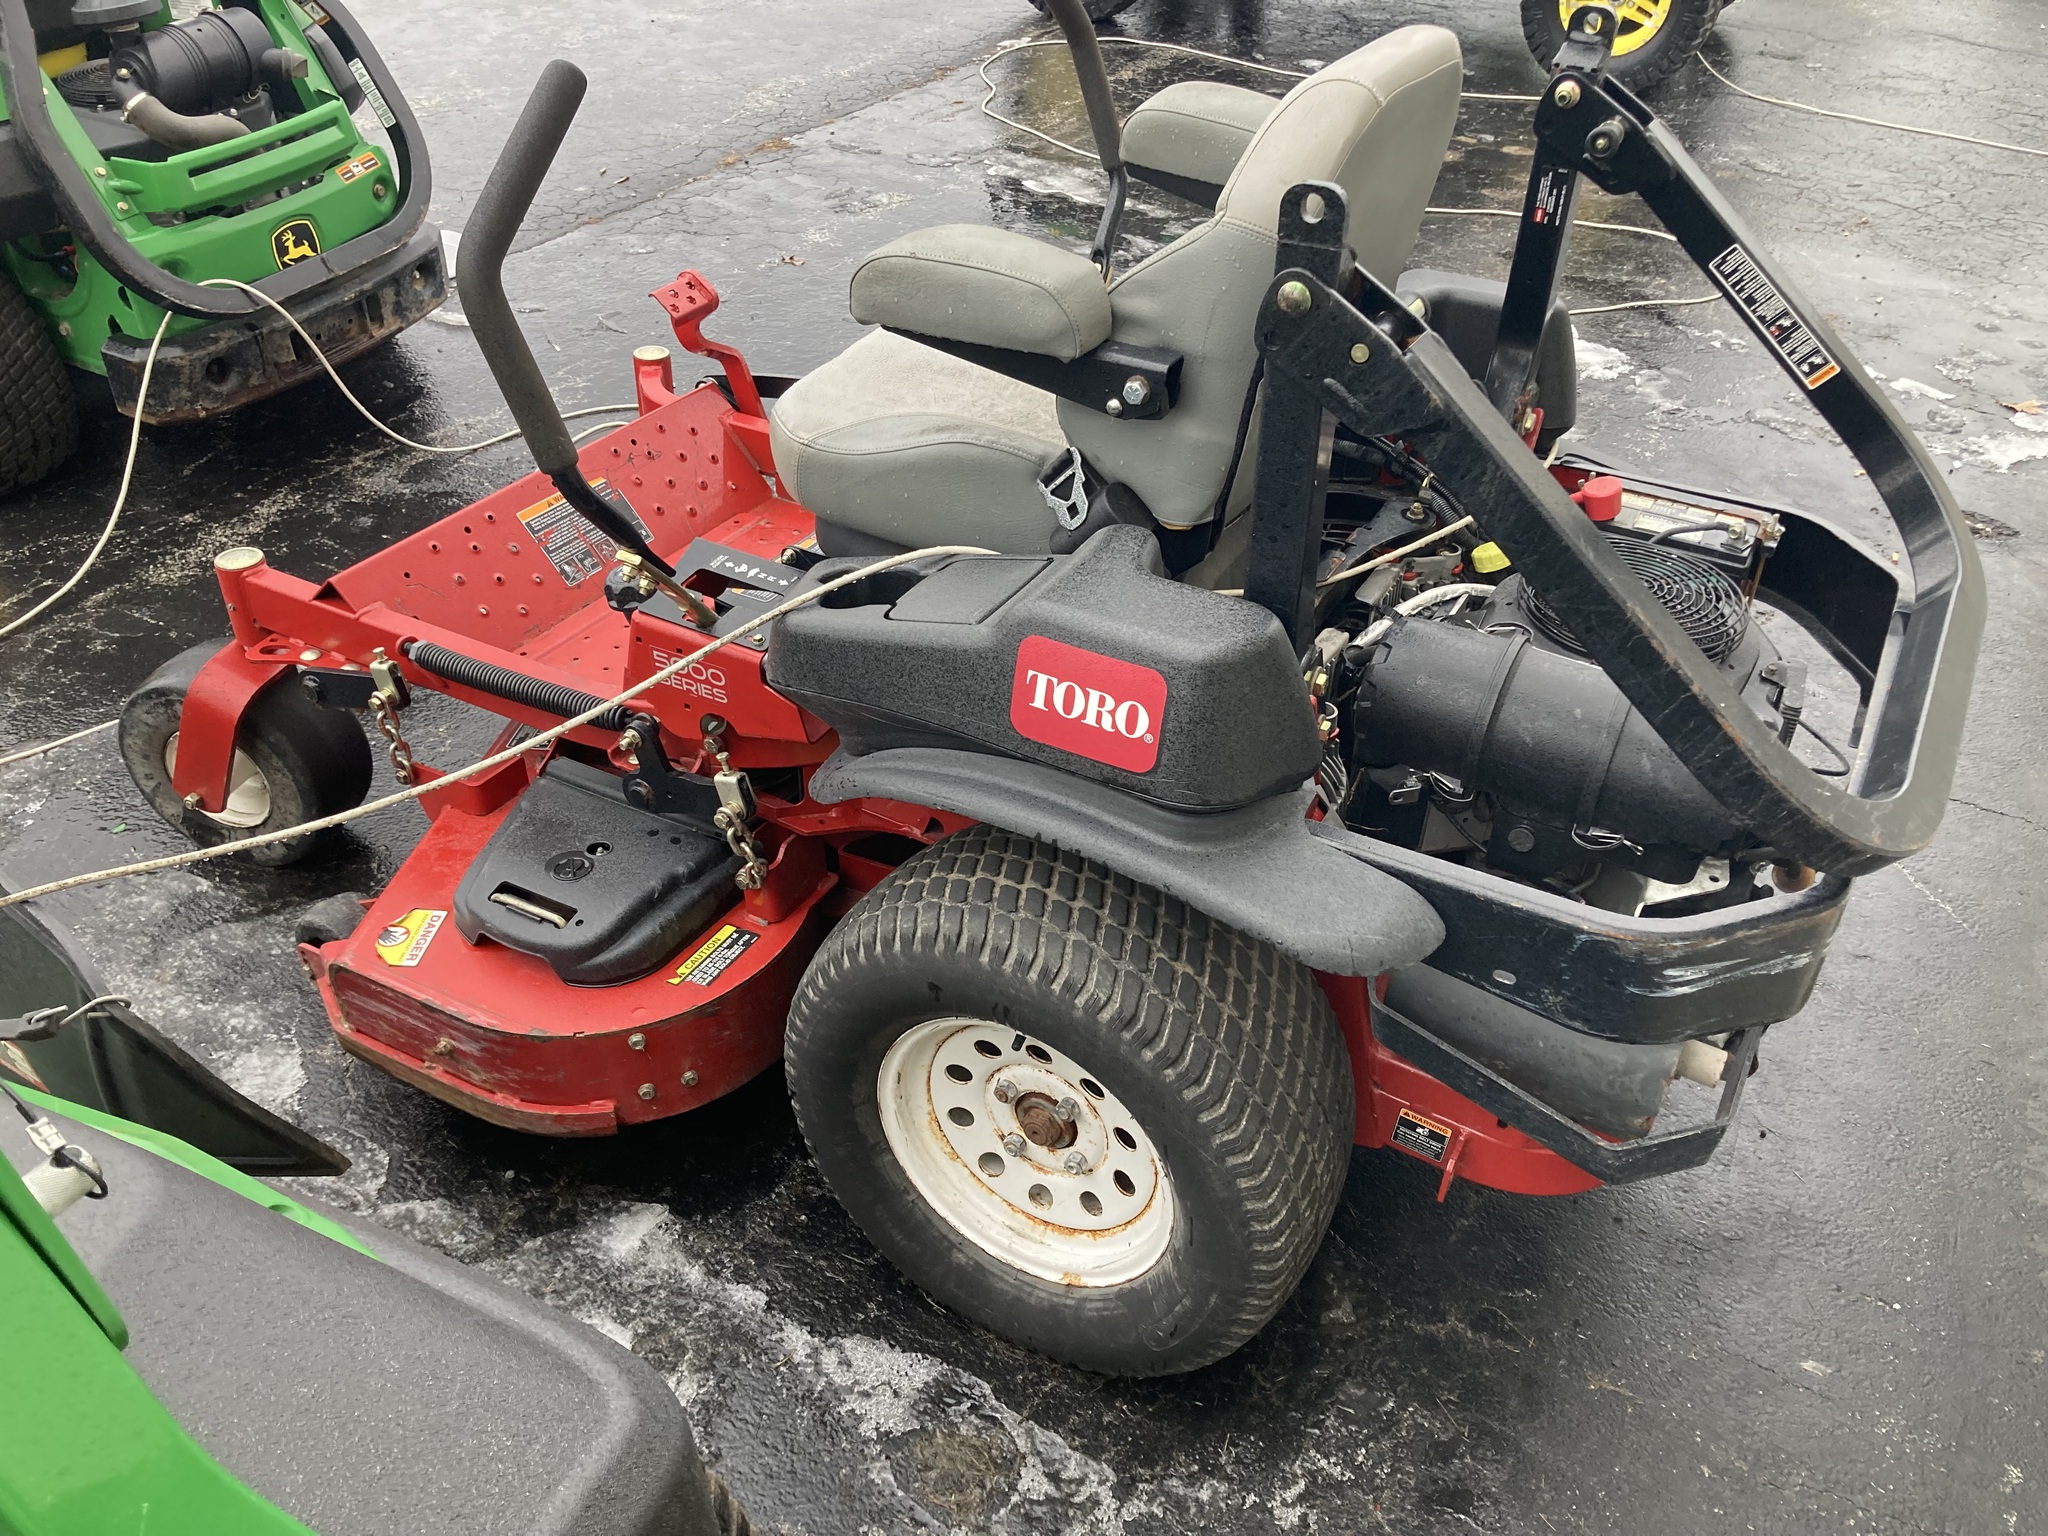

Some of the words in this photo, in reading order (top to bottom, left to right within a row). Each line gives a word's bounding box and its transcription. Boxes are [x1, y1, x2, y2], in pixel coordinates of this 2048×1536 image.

[406, 915, 442, 961] DANGER
[684, 937, 722, 970] CAUTION
[1411, 1114, 1448, 1134] WARNING
